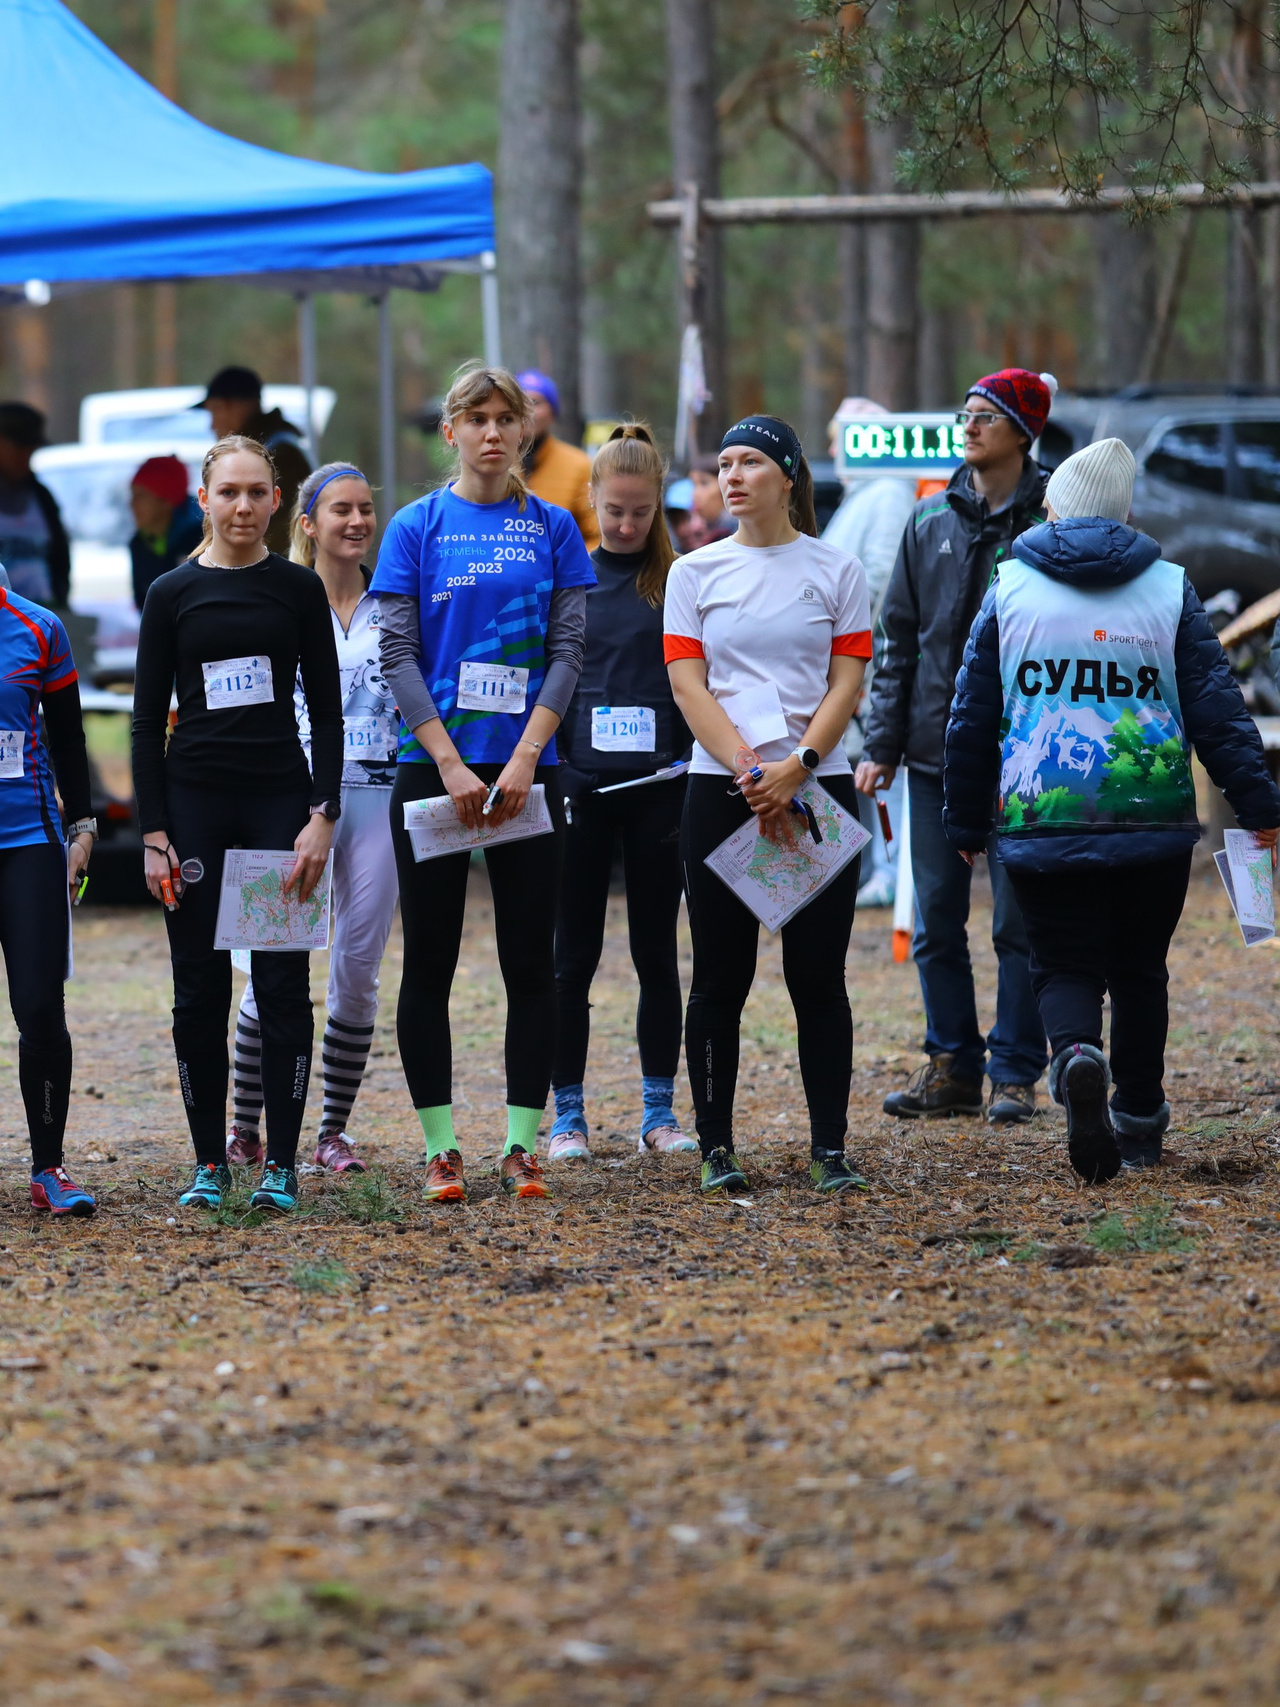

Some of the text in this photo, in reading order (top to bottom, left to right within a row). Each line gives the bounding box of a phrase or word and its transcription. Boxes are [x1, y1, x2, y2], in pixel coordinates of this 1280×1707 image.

[504, 518, 545, 536] 2025
[436, 533, 536, 544] ТРОПА ЗАЙЦЕВА
[438, 547, 487, 558] ТЮМЕНЬ
[493, 547, 536, 563] 2024
[467, 562, 503, 574] 2023
[446, 575, 476, 587] 2022
[431, 590, 452, 603] 2021
[226, 674, 253, 691] 112
[1018, 659, 1162, 703] СУДЬЯ
[481, 681, 505, 697] 111
[612, 722, 638, 736] 120
[348, 732, 371, 746] 121
[292, 1055, 307, 1100] noname
